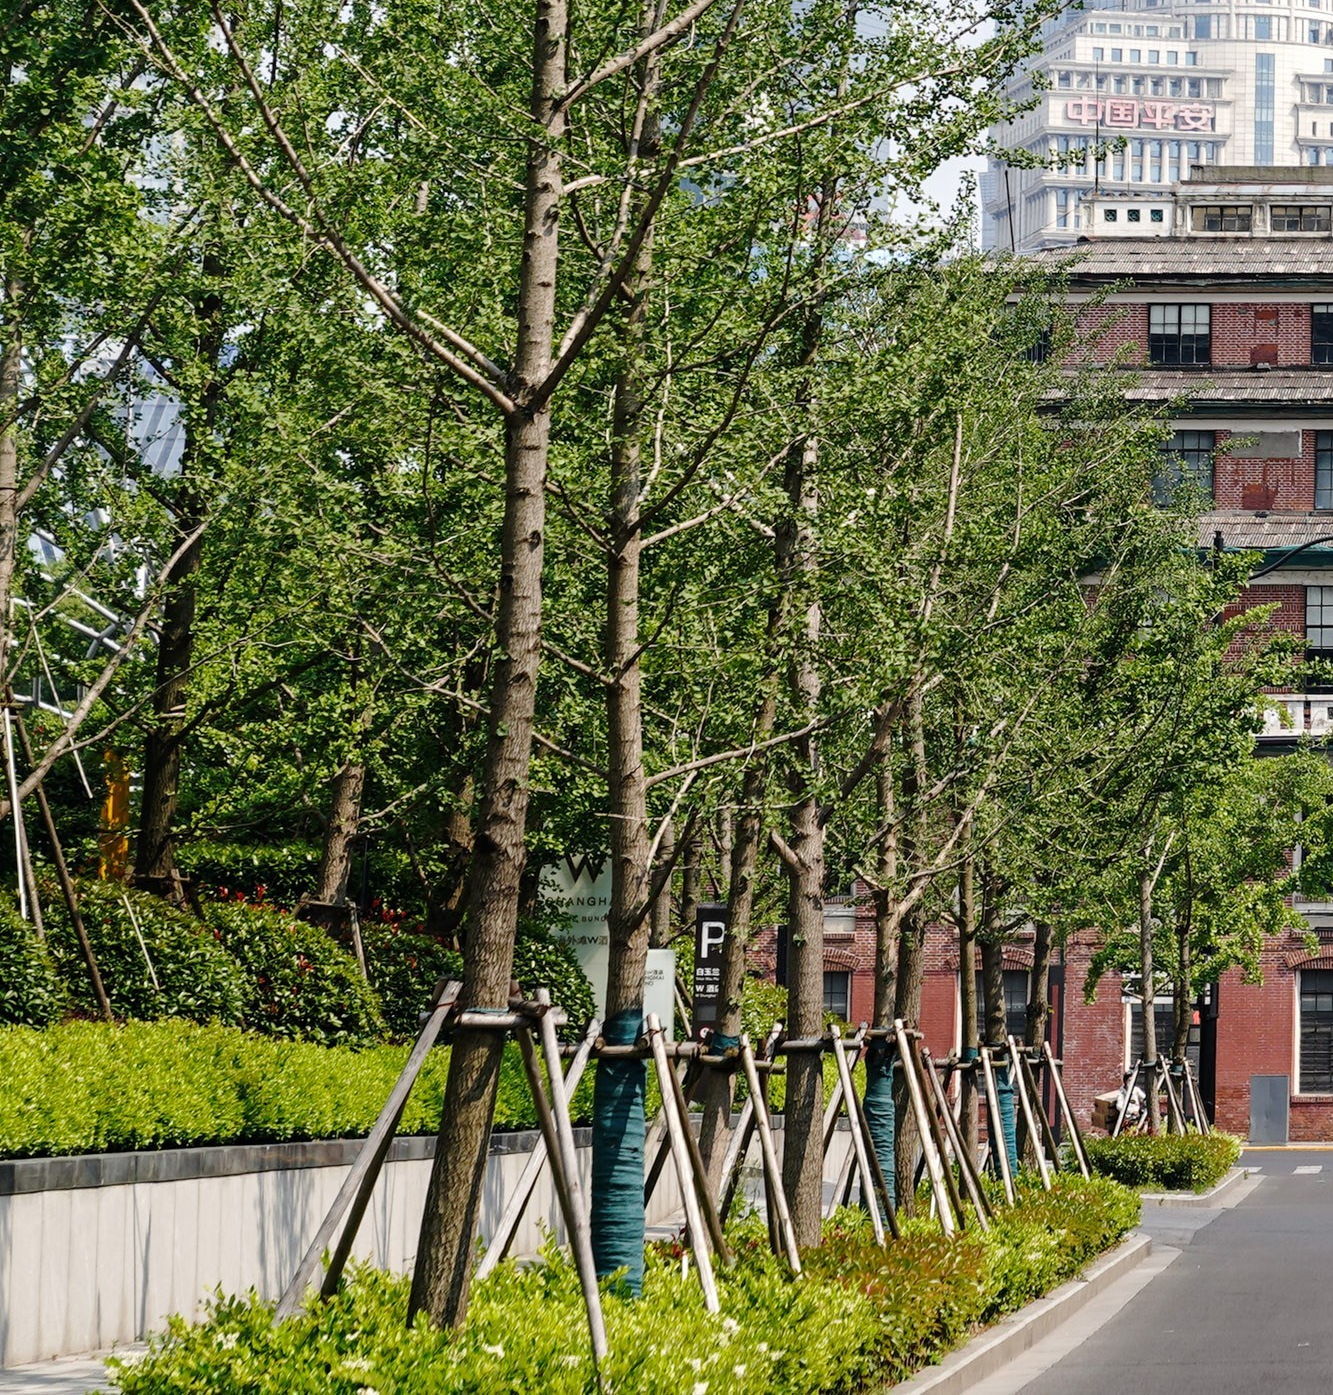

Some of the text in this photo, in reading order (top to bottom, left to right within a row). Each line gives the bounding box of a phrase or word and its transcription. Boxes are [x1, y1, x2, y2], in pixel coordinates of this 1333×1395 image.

[1066, 96, 1214, 132] 中国平安
[701, 921, 725, 958] P
